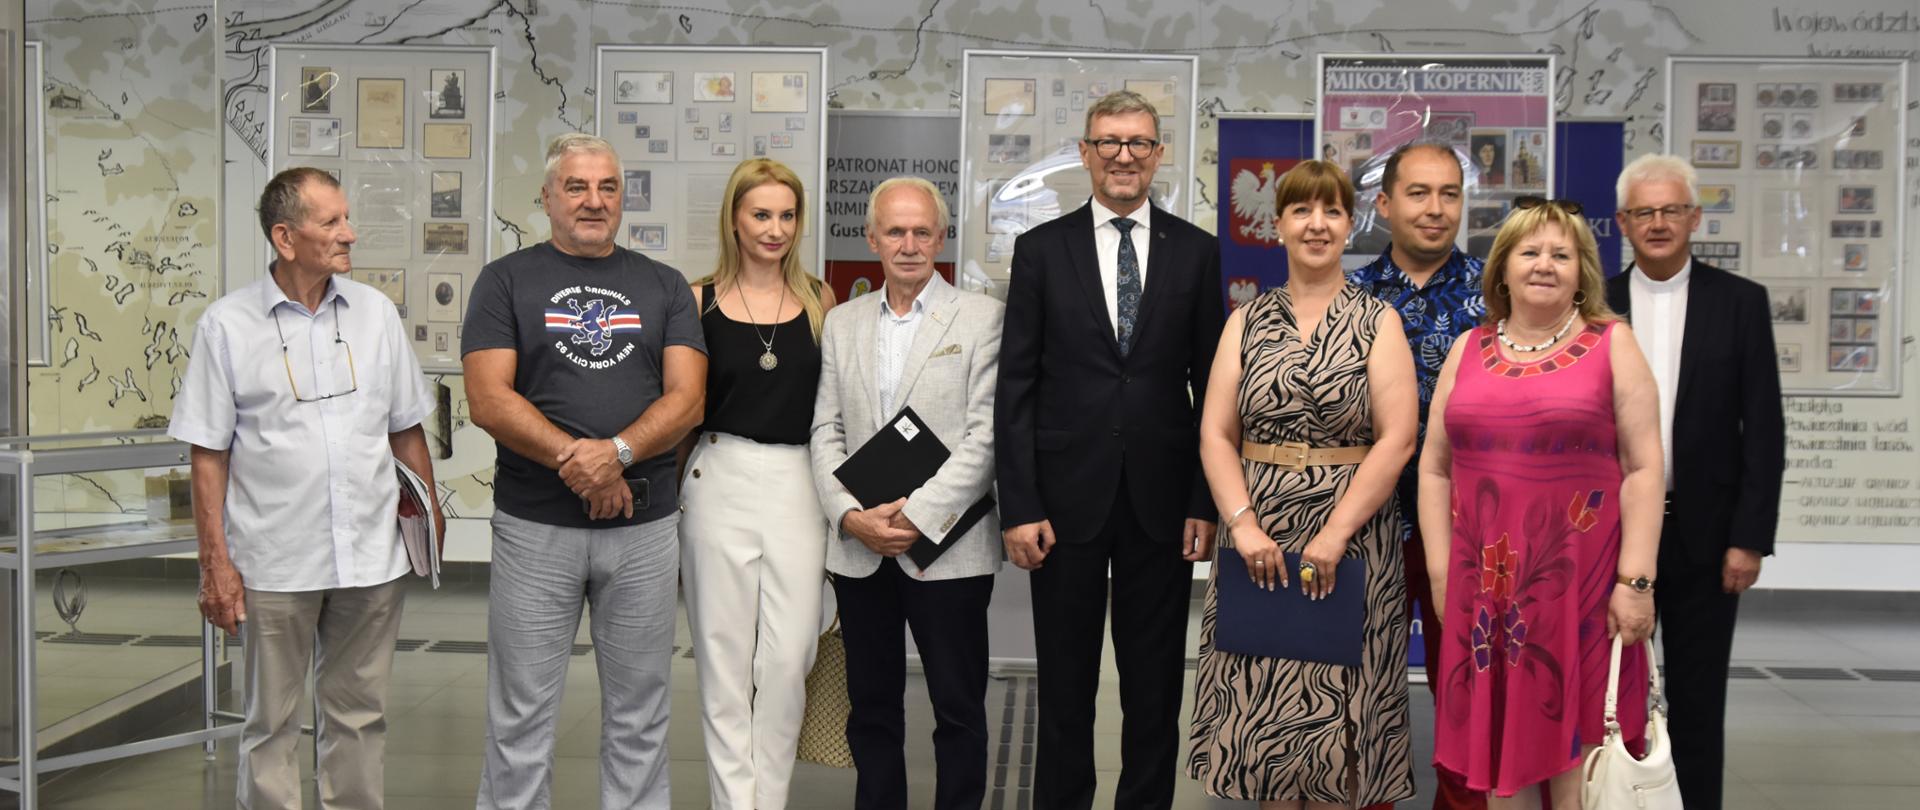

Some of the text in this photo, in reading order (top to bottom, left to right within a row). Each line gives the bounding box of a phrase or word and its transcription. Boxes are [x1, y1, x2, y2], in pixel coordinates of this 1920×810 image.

[1327, 71, 1527, 92] MIKOŁAJ KOPERNIK
[826, 158, 959, 174] PATRONAT HONO
[830, 223, 957, 239] Gust B
[1588, 217, 1612, 237] KI
[551, 286, 631, 306] DIVERSE ORIGINALS
[555, 341, 635, 369] NEW YORK CITY 93
